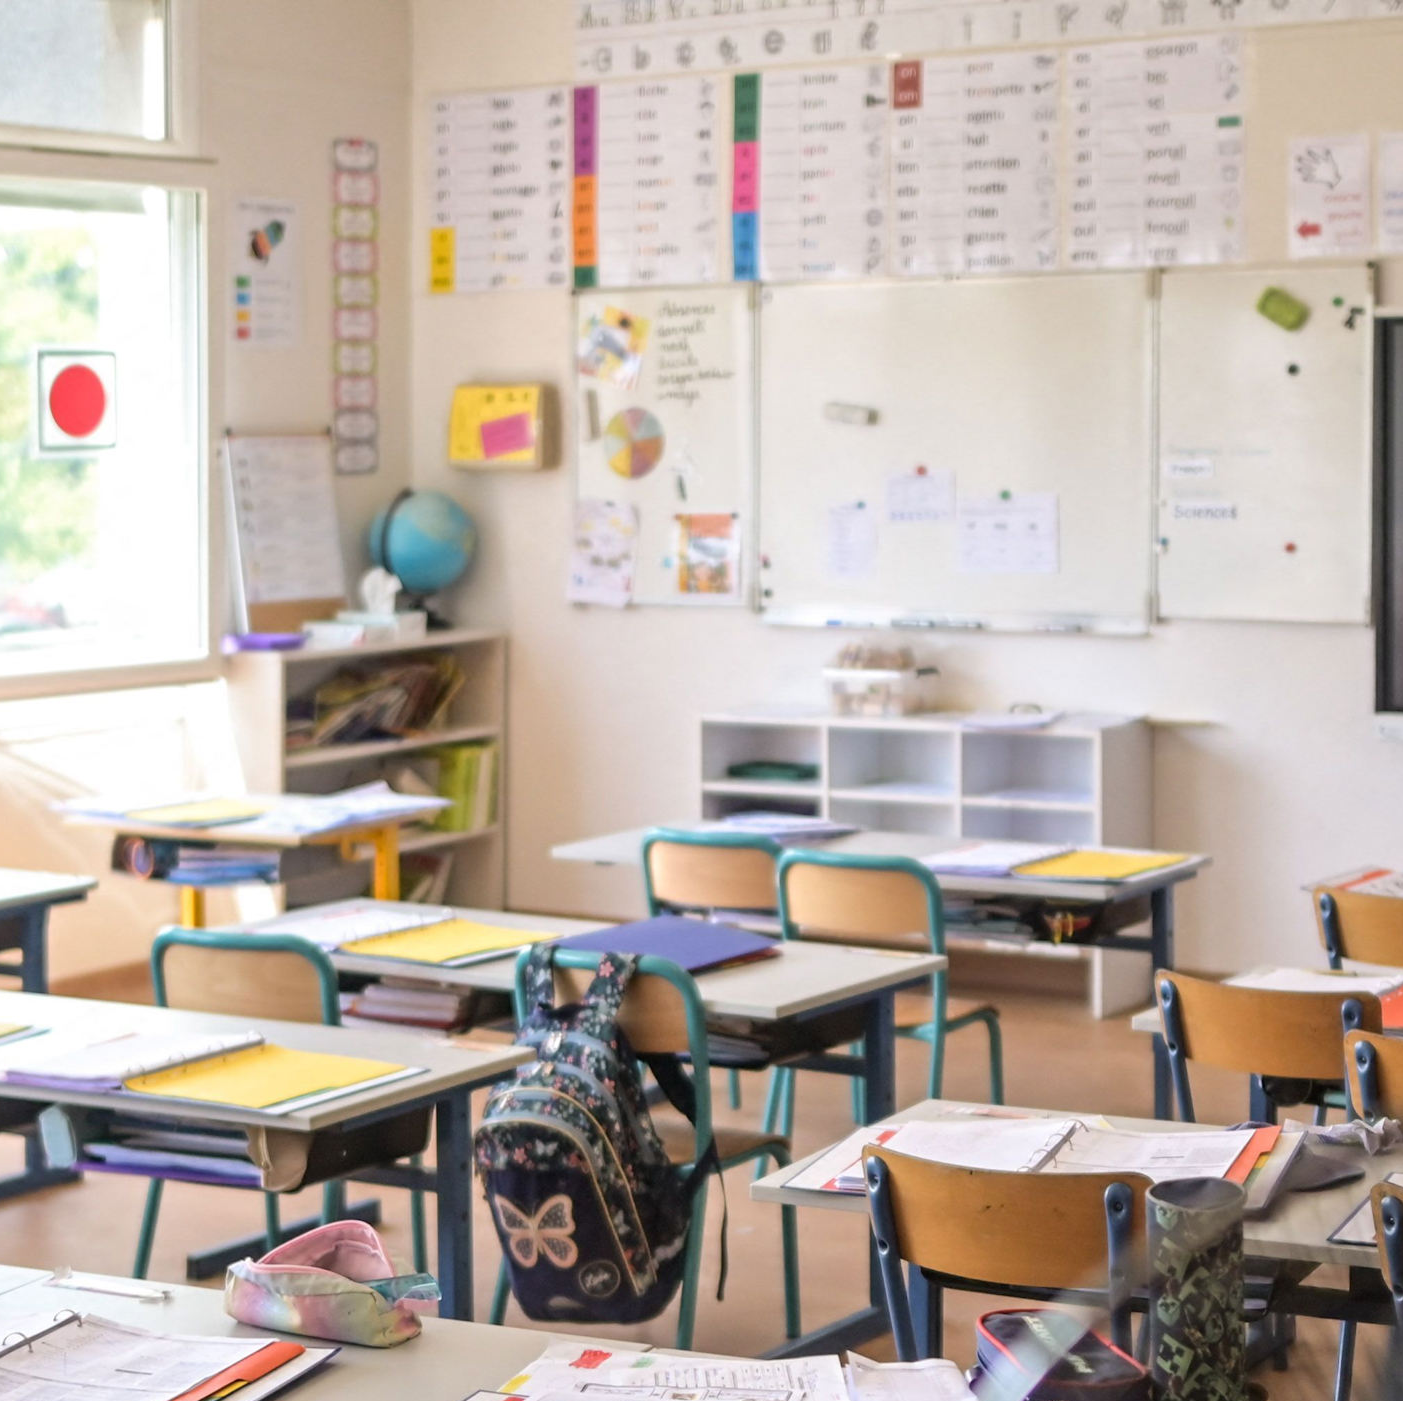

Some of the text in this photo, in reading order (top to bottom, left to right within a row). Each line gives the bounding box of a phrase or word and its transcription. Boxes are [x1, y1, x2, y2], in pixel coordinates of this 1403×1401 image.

[1146, 42, 1198, 59] escargot
[901, 61, 994, 78] on pont
[967, 83, 1025, 98] trompette
[966, 157, 1020, 170] attention
[967, 182, 1008, 195] recette
[967, 207, 998, 219] chien
[967, 231, 1007, 246] guitare
